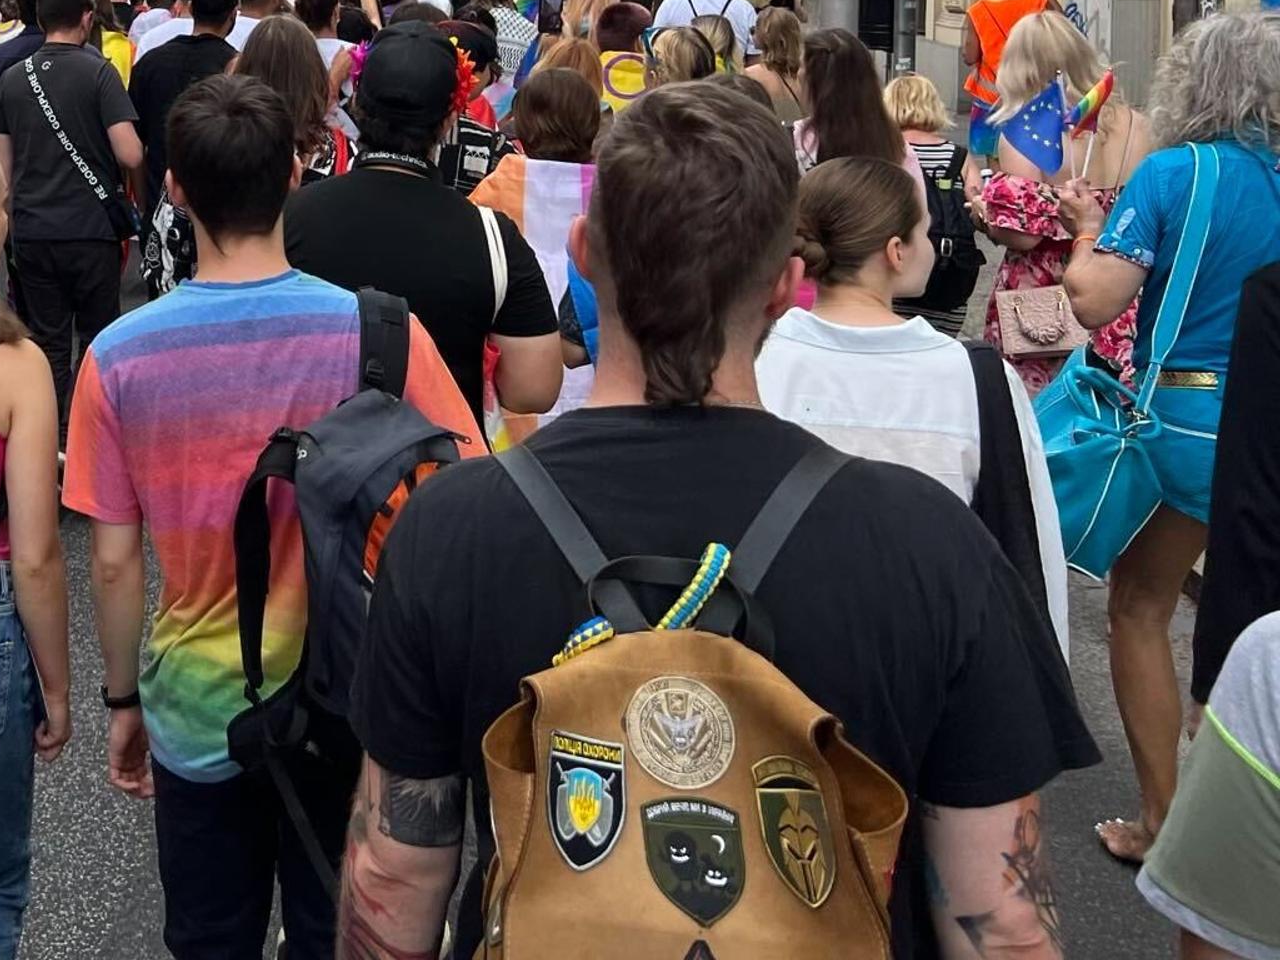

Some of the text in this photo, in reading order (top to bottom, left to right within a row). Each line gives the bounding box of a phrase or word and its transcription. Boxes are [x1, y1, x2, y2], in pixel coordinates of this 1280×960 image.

[27, 72, 61, 130] GOEXPLORE
[57, 130, 99, 186] GOEXPLORE
[367, 150, 429, 169] audio-technica
